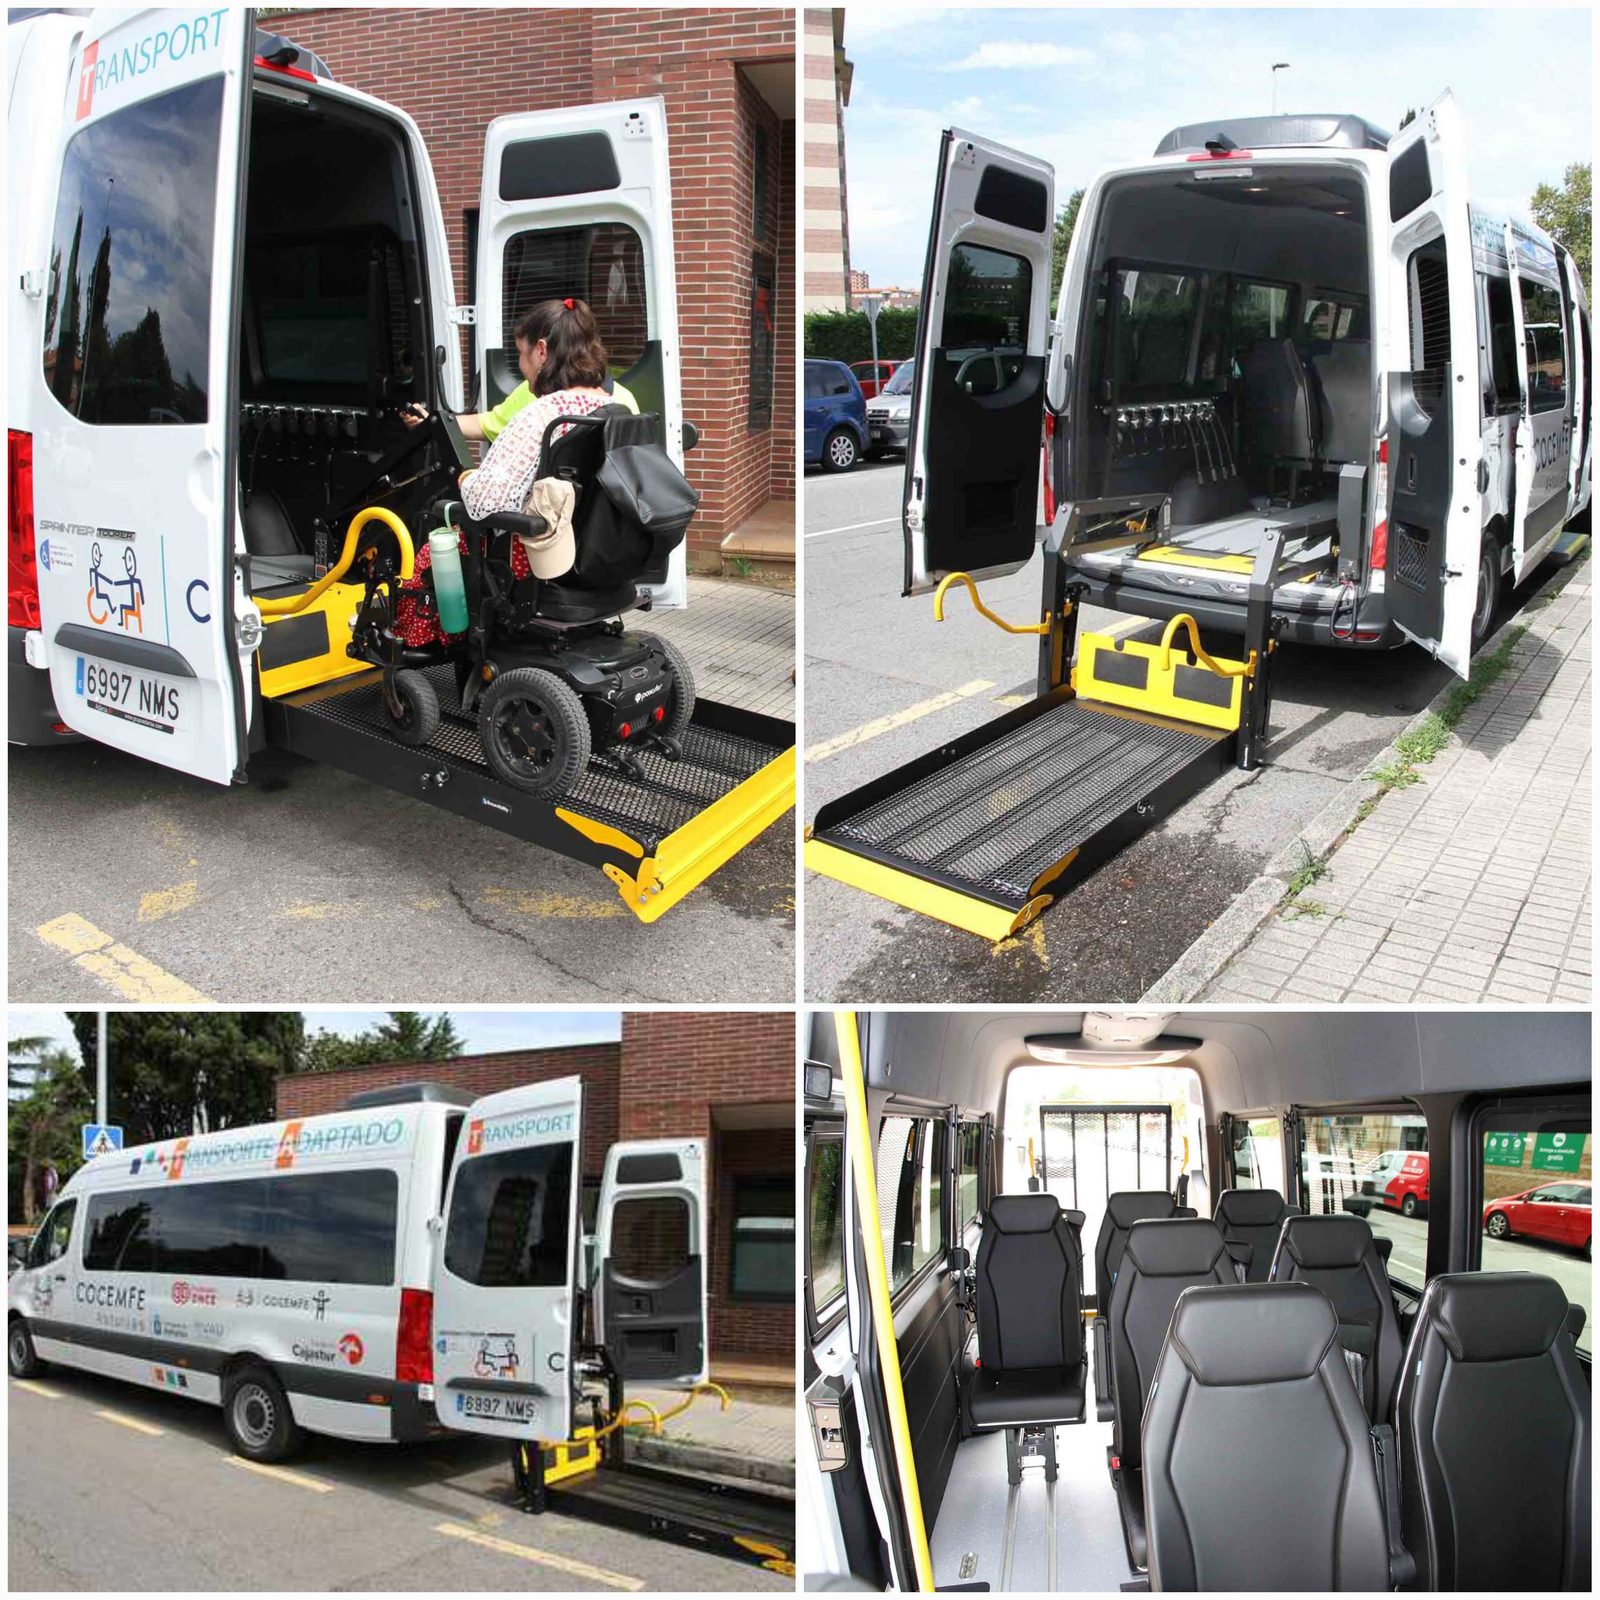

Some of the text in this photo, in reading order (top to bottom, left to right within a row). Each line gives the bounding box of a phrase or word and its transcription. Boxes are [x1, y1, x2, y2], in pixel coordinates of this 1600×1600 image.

[82, 8, 229, 102] TRANSPORT
[40, 520, 95, 536] SPRINTER
[186, 579, 211, 624] C
[87, 664, 179, 721] 6997 NMS
[472, 1113, 575, 1146] TRANSPORT
[76, 1281, 146, 1311] COCEMFE
